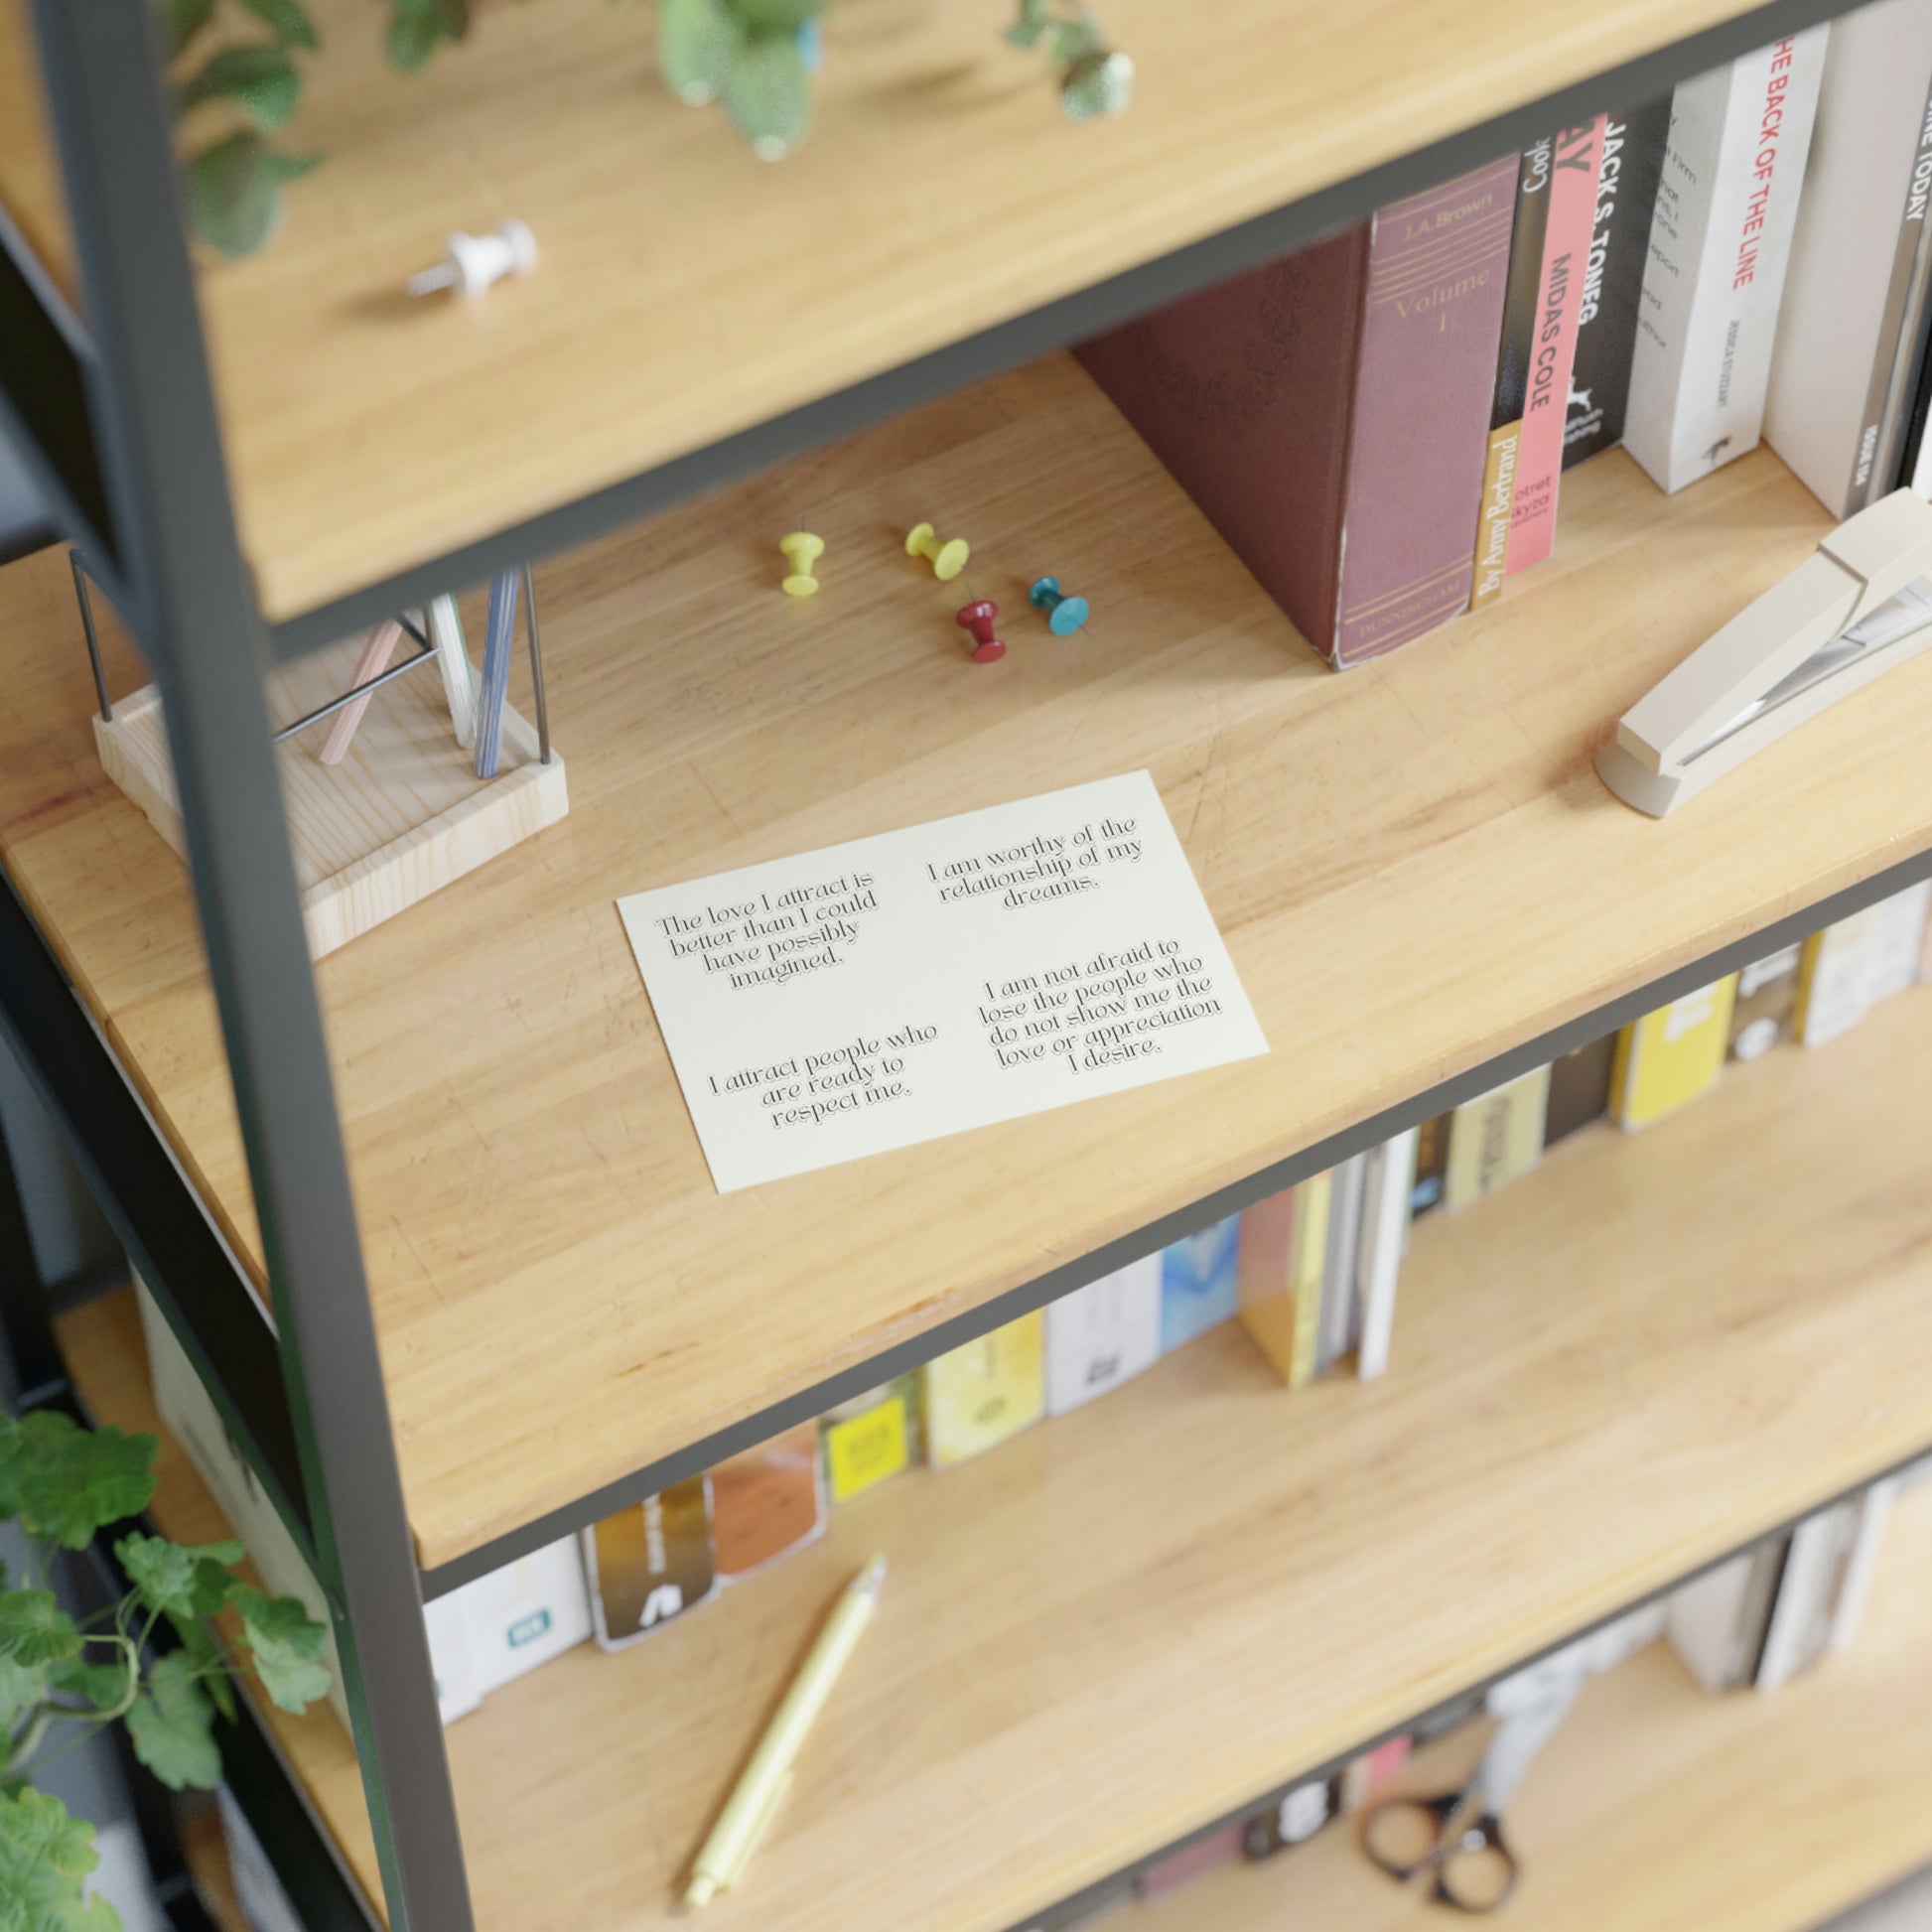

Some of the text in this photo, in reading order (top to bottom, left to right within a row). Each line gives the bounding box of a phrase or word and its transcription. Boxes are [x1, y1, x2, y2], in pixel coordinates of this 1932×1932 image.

[1555, 118, 1595, 173] AY
[1597, 122, 1626, 194] JACK
[1732, 35, 1794, 291] HE BACK OF THE LINE
[1395, 269, 1490, 319] Volume
[1531, 252, 1572, 413] MIDAS COLE
[1478, 434, 1517, 597] By Anny Bertrand
[927, 818, 1136, 881] I am worthy of the
[939, 840, 1142, 901] relationship of my
[657, 872, 875, 935] The love I attract is
[1003, 876, 1099, 907] dreams.
[669, 890, 878, 957] better than I could
[703, 921, 860, 971] have possibly
[730, 946, 843, 988] imagined.
[978, 957, 1203, 1025] lose the people who
[985, 940, 1178, 1000] I am not afraid to
[990, 978, 1212, 1044] do not show me the
[995, 999, 1222, 1067] love or appreciation
[708, 1025, 938, 1094] I attract people who
[762, 1057, 904, 1106] are ready to
[1068, 1039, 1162, 1072] I desire.
[771, 1082, 911, 1127] respect me.
